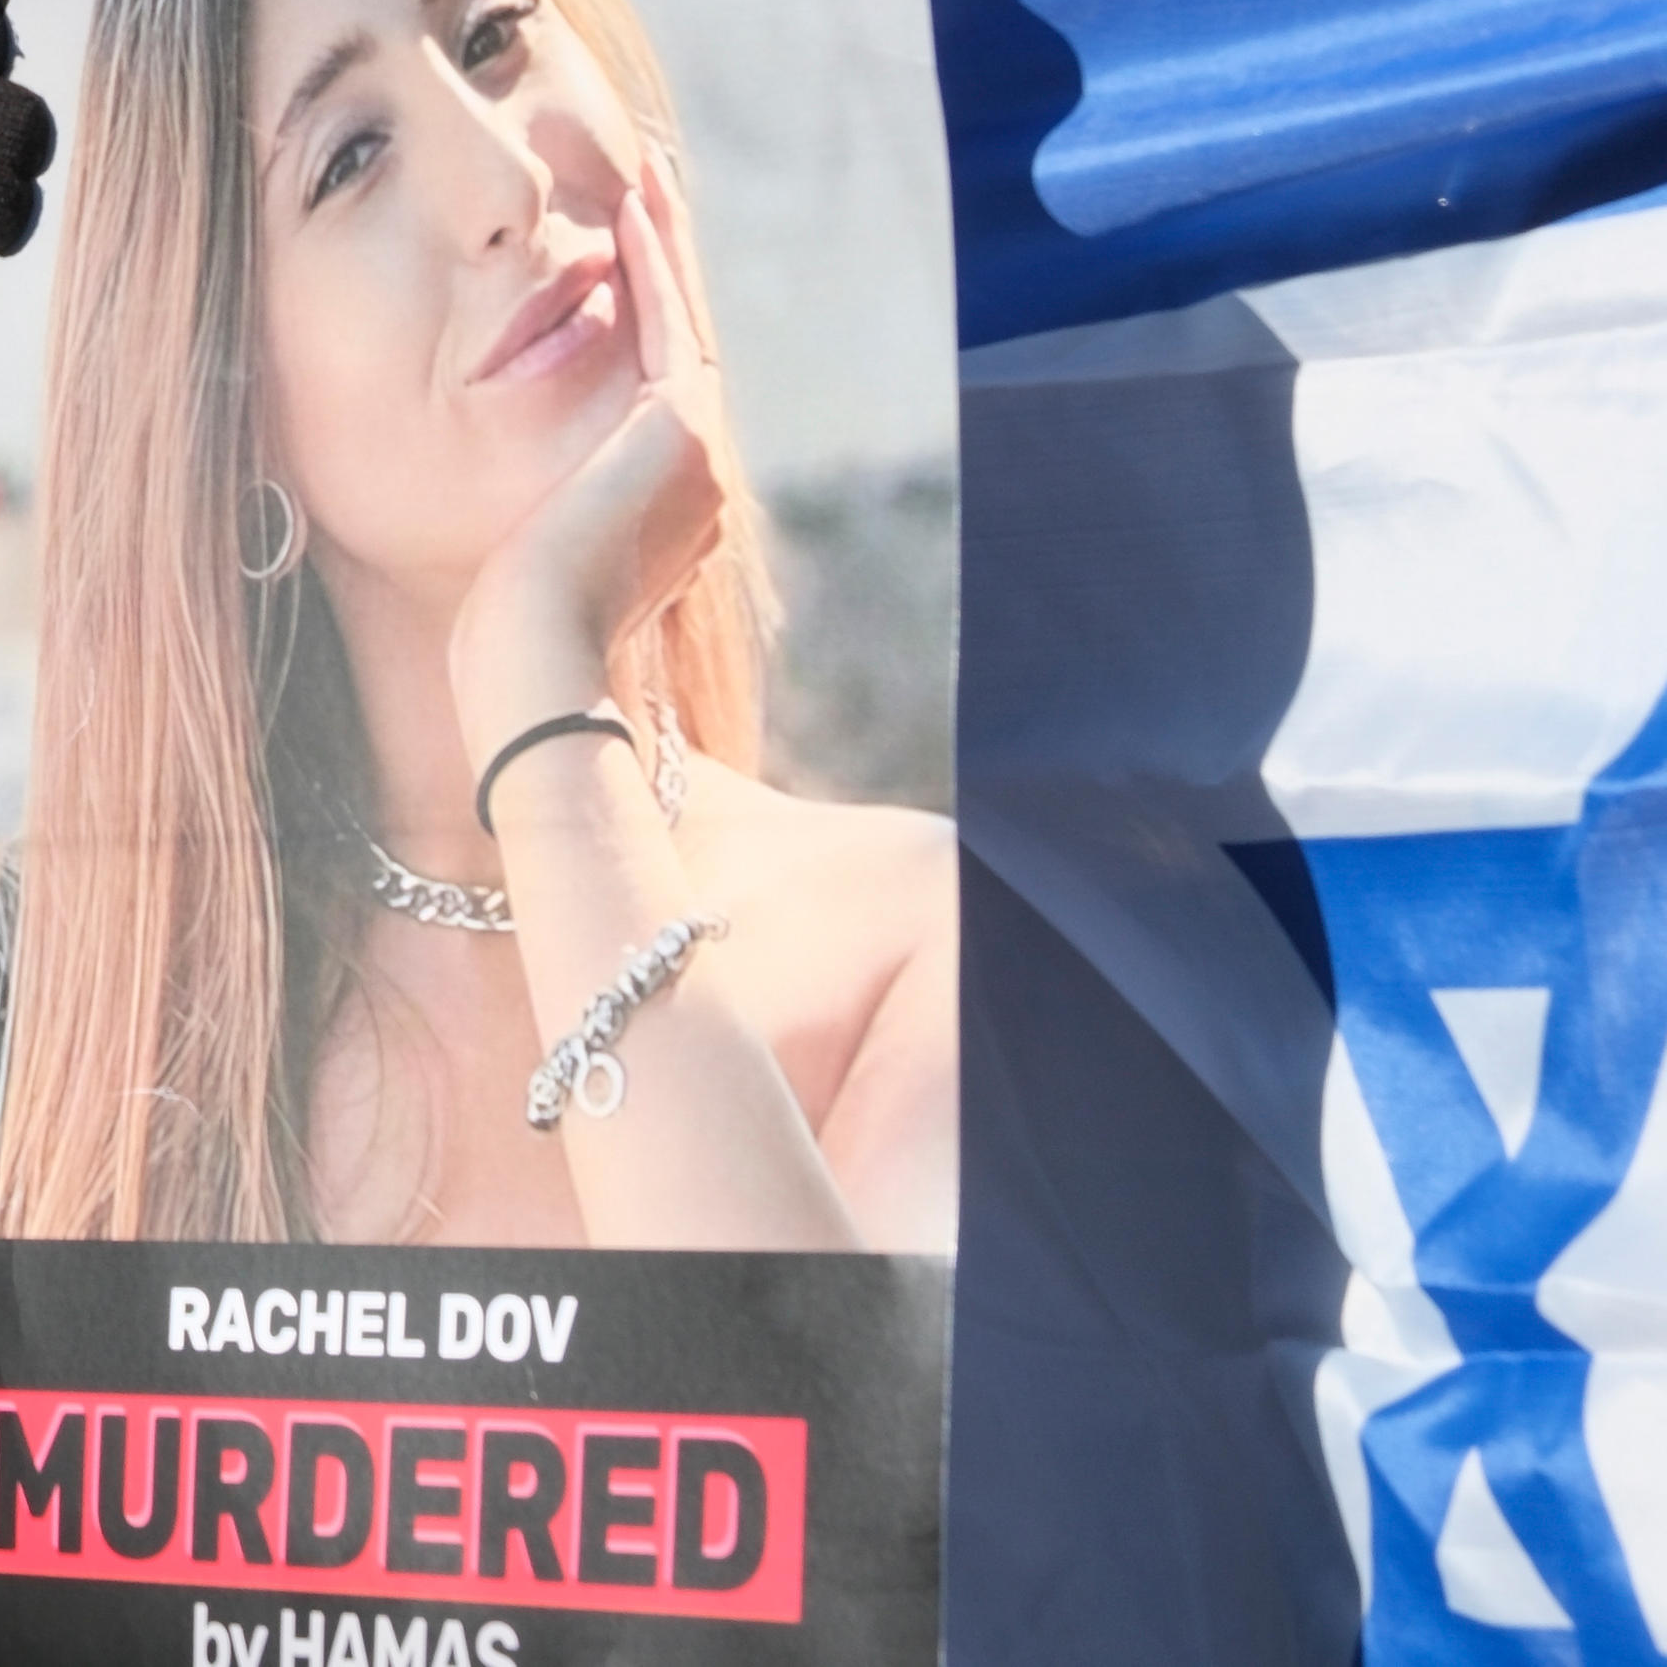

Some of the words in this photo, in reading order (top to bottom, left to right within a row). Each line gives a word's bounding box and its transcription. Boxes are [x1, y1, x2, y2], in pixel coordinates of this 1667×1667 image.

[167, 1285, 427, 1360] RACHEL
[437, 1291, 579, 1364] DOV
[192, 1601, 269, 1667] by
[279, 1607, 520, 1667] HAMAS
